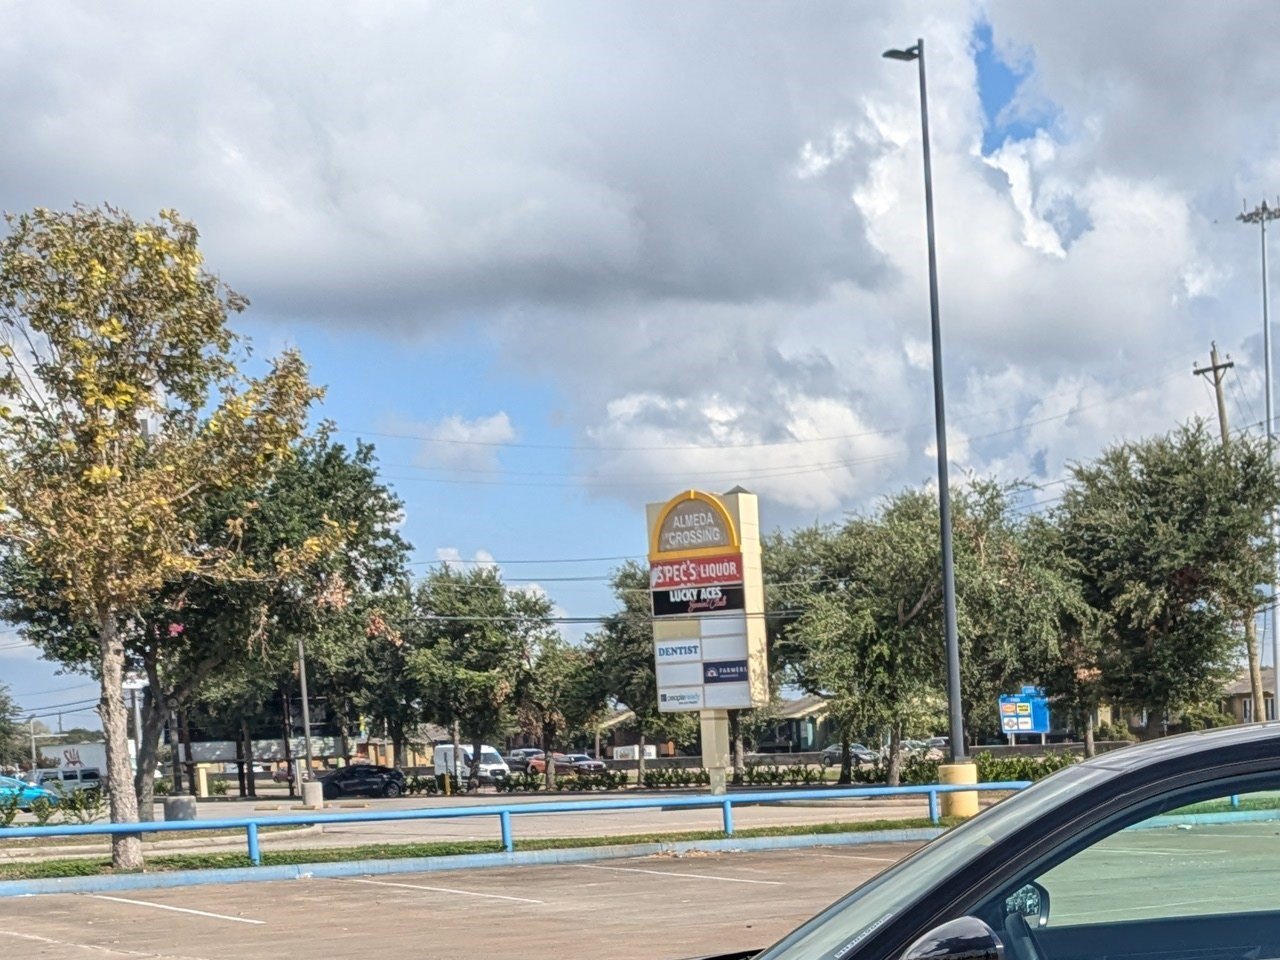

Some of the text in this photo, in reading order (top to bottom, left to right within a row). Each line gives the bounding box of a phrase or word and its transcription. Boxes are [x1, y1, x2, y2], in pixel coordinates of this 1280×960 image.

[673, 512, 714, 528] ALMEDA
[668, 527, 720, 545] CROSSING
[657, 560, 737, 583] SPEC'S LIQUOR
[669, 587, 722, 602] LUCKY ACES
[658, 645, 699, 656] DENTIST
